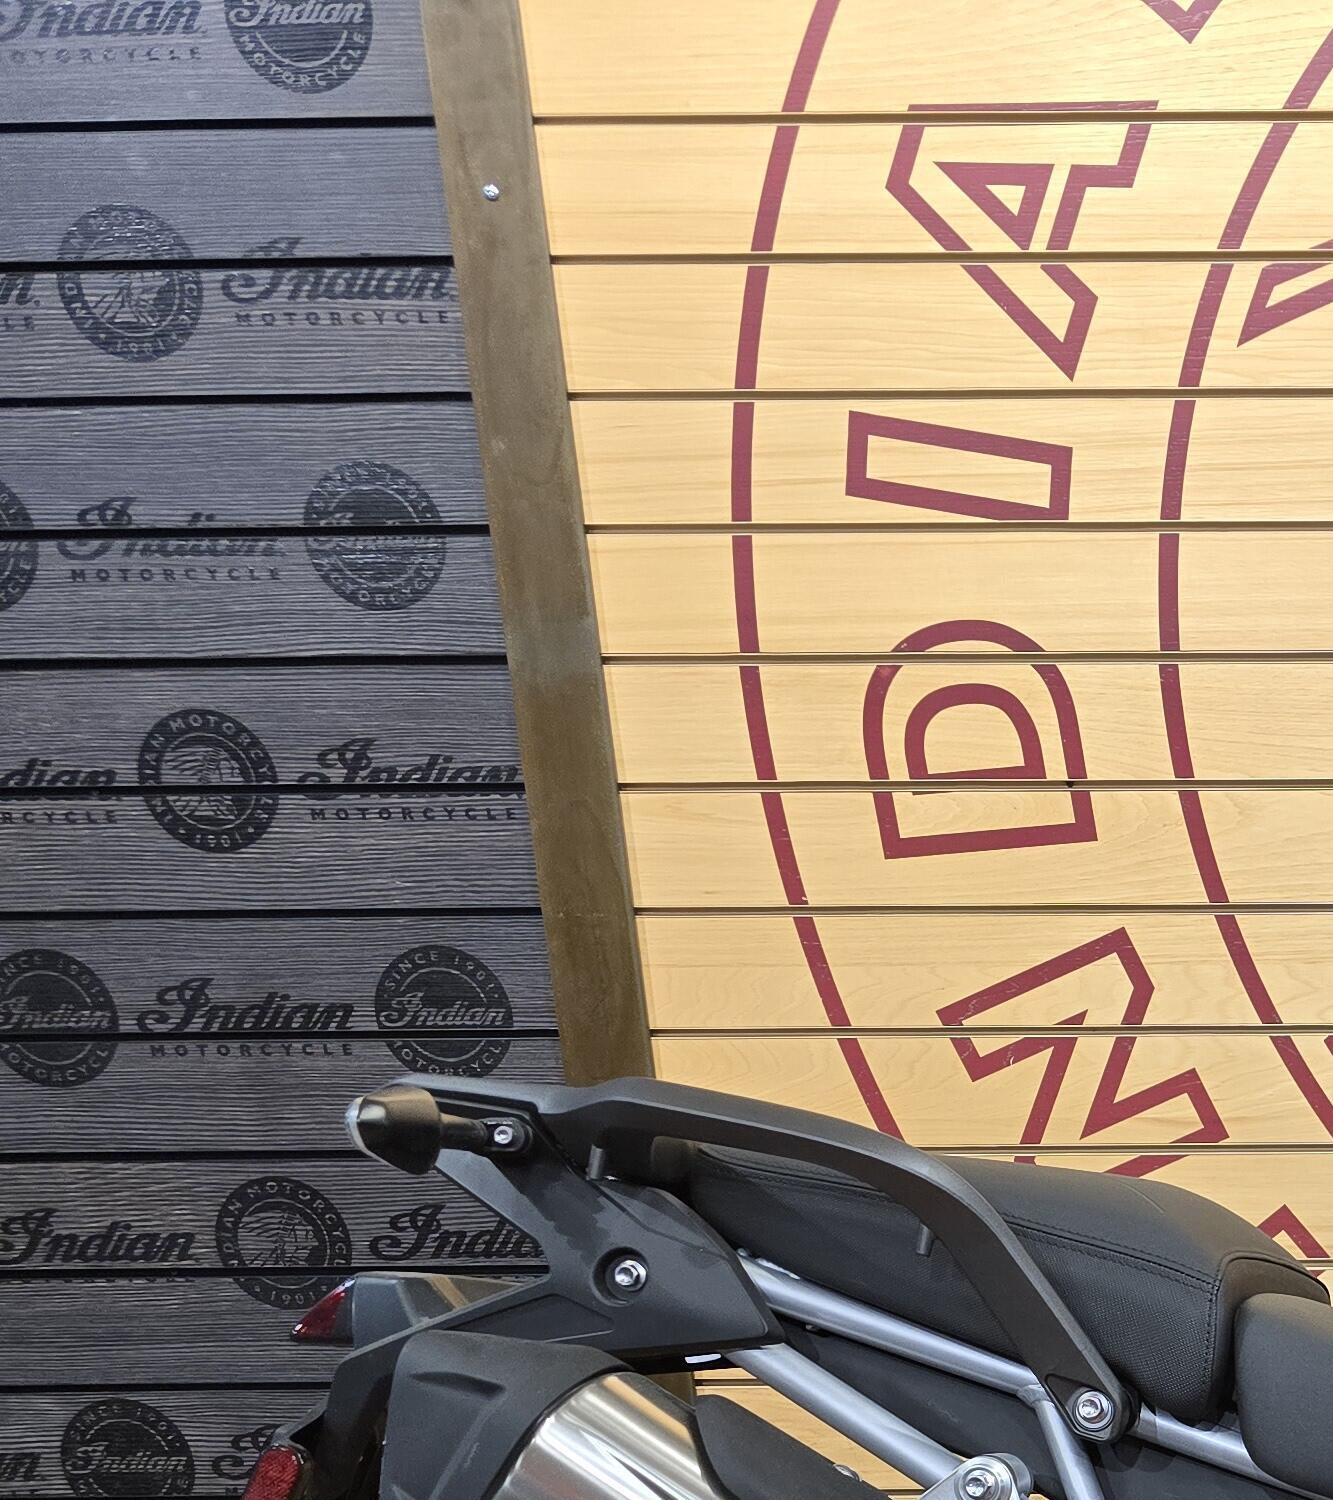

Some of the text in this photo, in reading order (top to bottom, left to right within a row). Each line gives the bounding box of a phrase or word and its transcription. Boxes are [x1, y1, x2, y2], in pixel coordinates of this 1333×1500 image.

[234, 311, 450, 326] MOTORCYCLE
[70, 567, 282, 583] MOTORCYCLE
[0, 758, 118, 799] dian
[310, 807, 518, 821] MOTORCYCLE
[385, 950, 439, 988] SINCE
[137, 977, 355, 1034] Indian
[378, 991, 505, 1028] Indian
[150, 1042, 353, 1057] MOTORCYCLE
[0, 1208, 197, 1264] Indian
[369, 1204, 544, 1261] India
